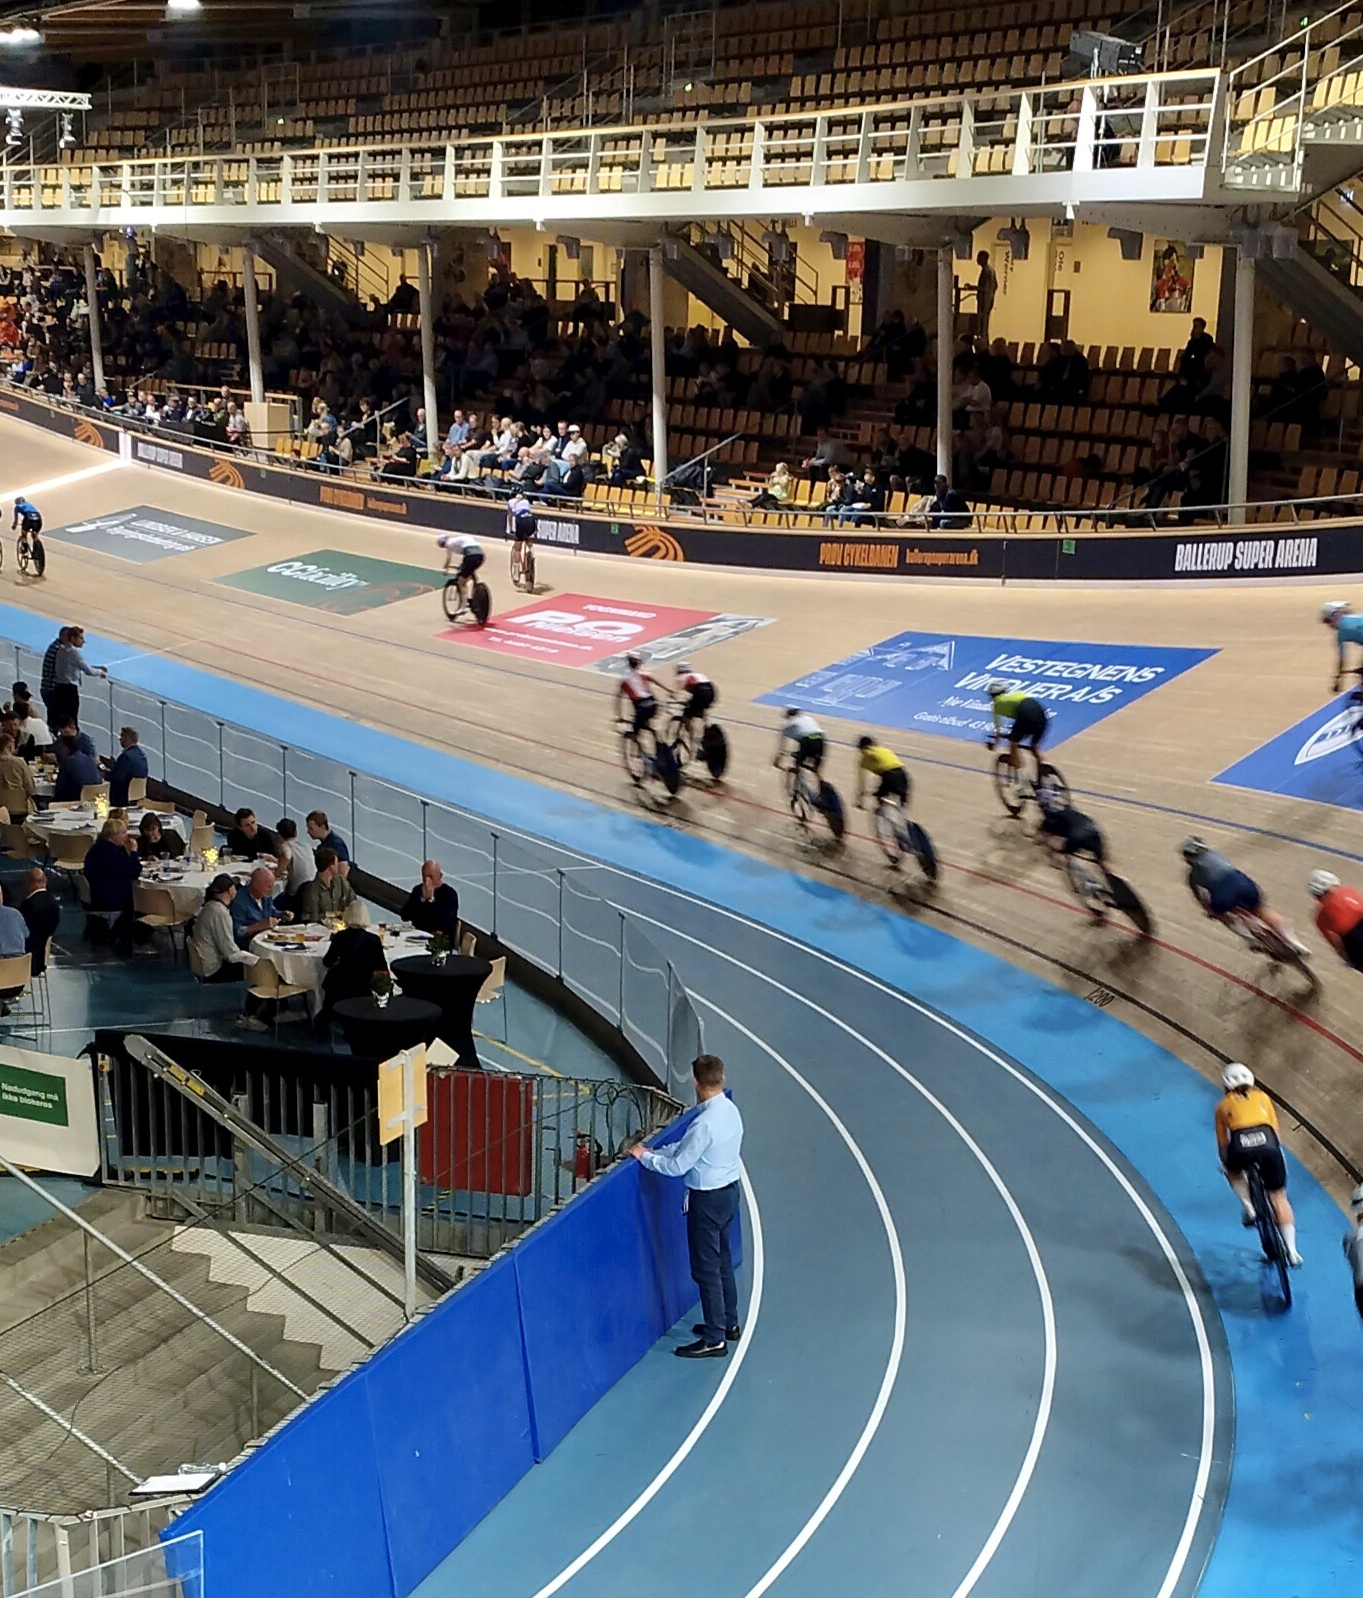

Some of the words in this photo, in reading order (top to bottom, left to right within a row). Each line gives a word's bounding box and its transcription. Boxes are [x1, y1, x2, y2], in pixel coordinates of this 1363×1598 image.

[1174, 542, 1234, 571] BALLERUP
[1234, 540, 1274, 570] SUPER
[1275, 537, 1318, 568] ARENA
[985, 653, 1166, 683] VESTEGNENS
